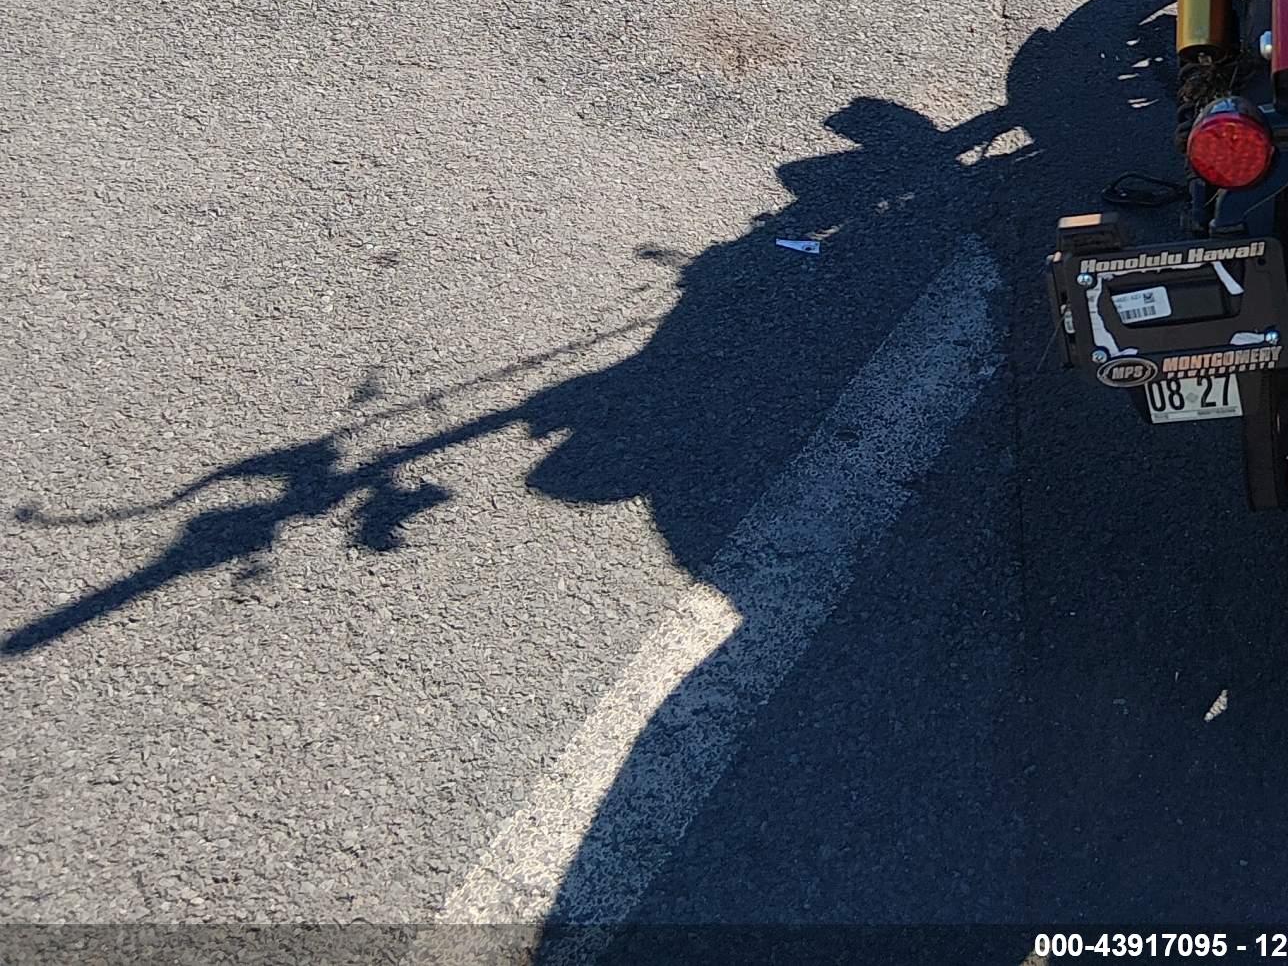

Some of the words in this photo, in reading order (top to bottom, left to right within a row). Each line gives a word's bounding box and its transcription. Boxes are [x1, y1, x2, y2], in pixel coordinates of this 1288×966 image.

[1080, 251, 1183, 274] Honolulu
[1187, 241, 1265, 263] Hawaii
[1111, 365, 1144, 380] MPS
[1149, 378, 1186, 413] 08
[1196, 374, 1231, 409] 27
